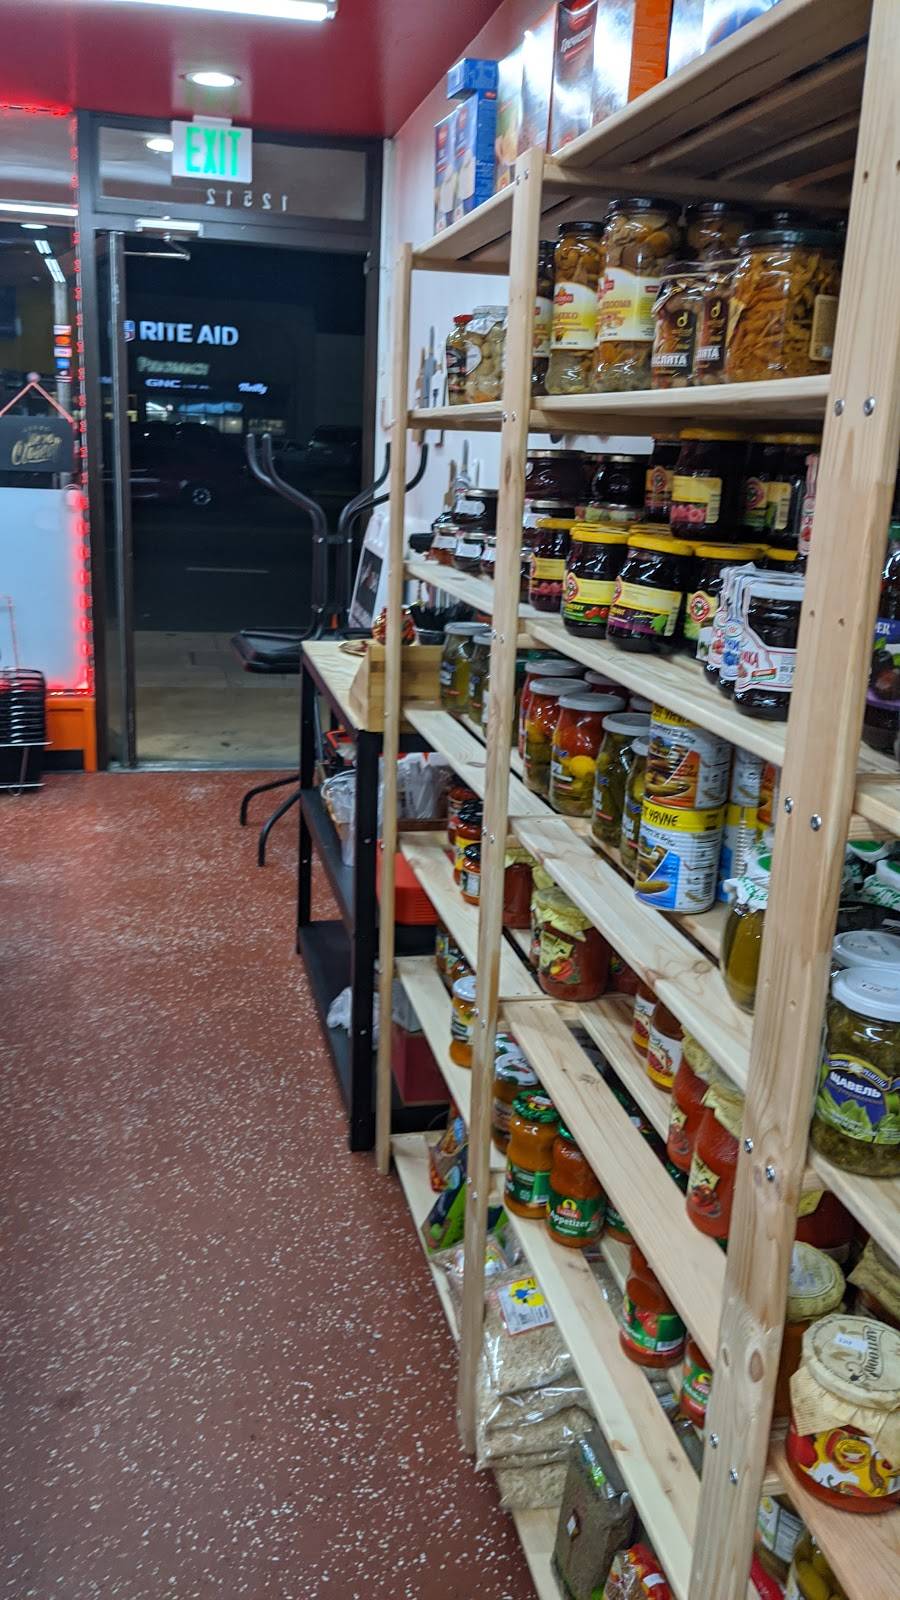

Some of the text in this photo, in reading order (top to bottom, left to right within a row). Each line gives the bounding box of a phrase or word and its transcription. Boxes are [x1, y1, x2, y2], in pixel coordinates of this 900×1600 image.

[186, 126, 242, 177] EXIT
[140, 321, 239, 345] RITE AID
[145, 378, 181, 389] GNC
[550, 1210, 589, 1228] Appetizer
